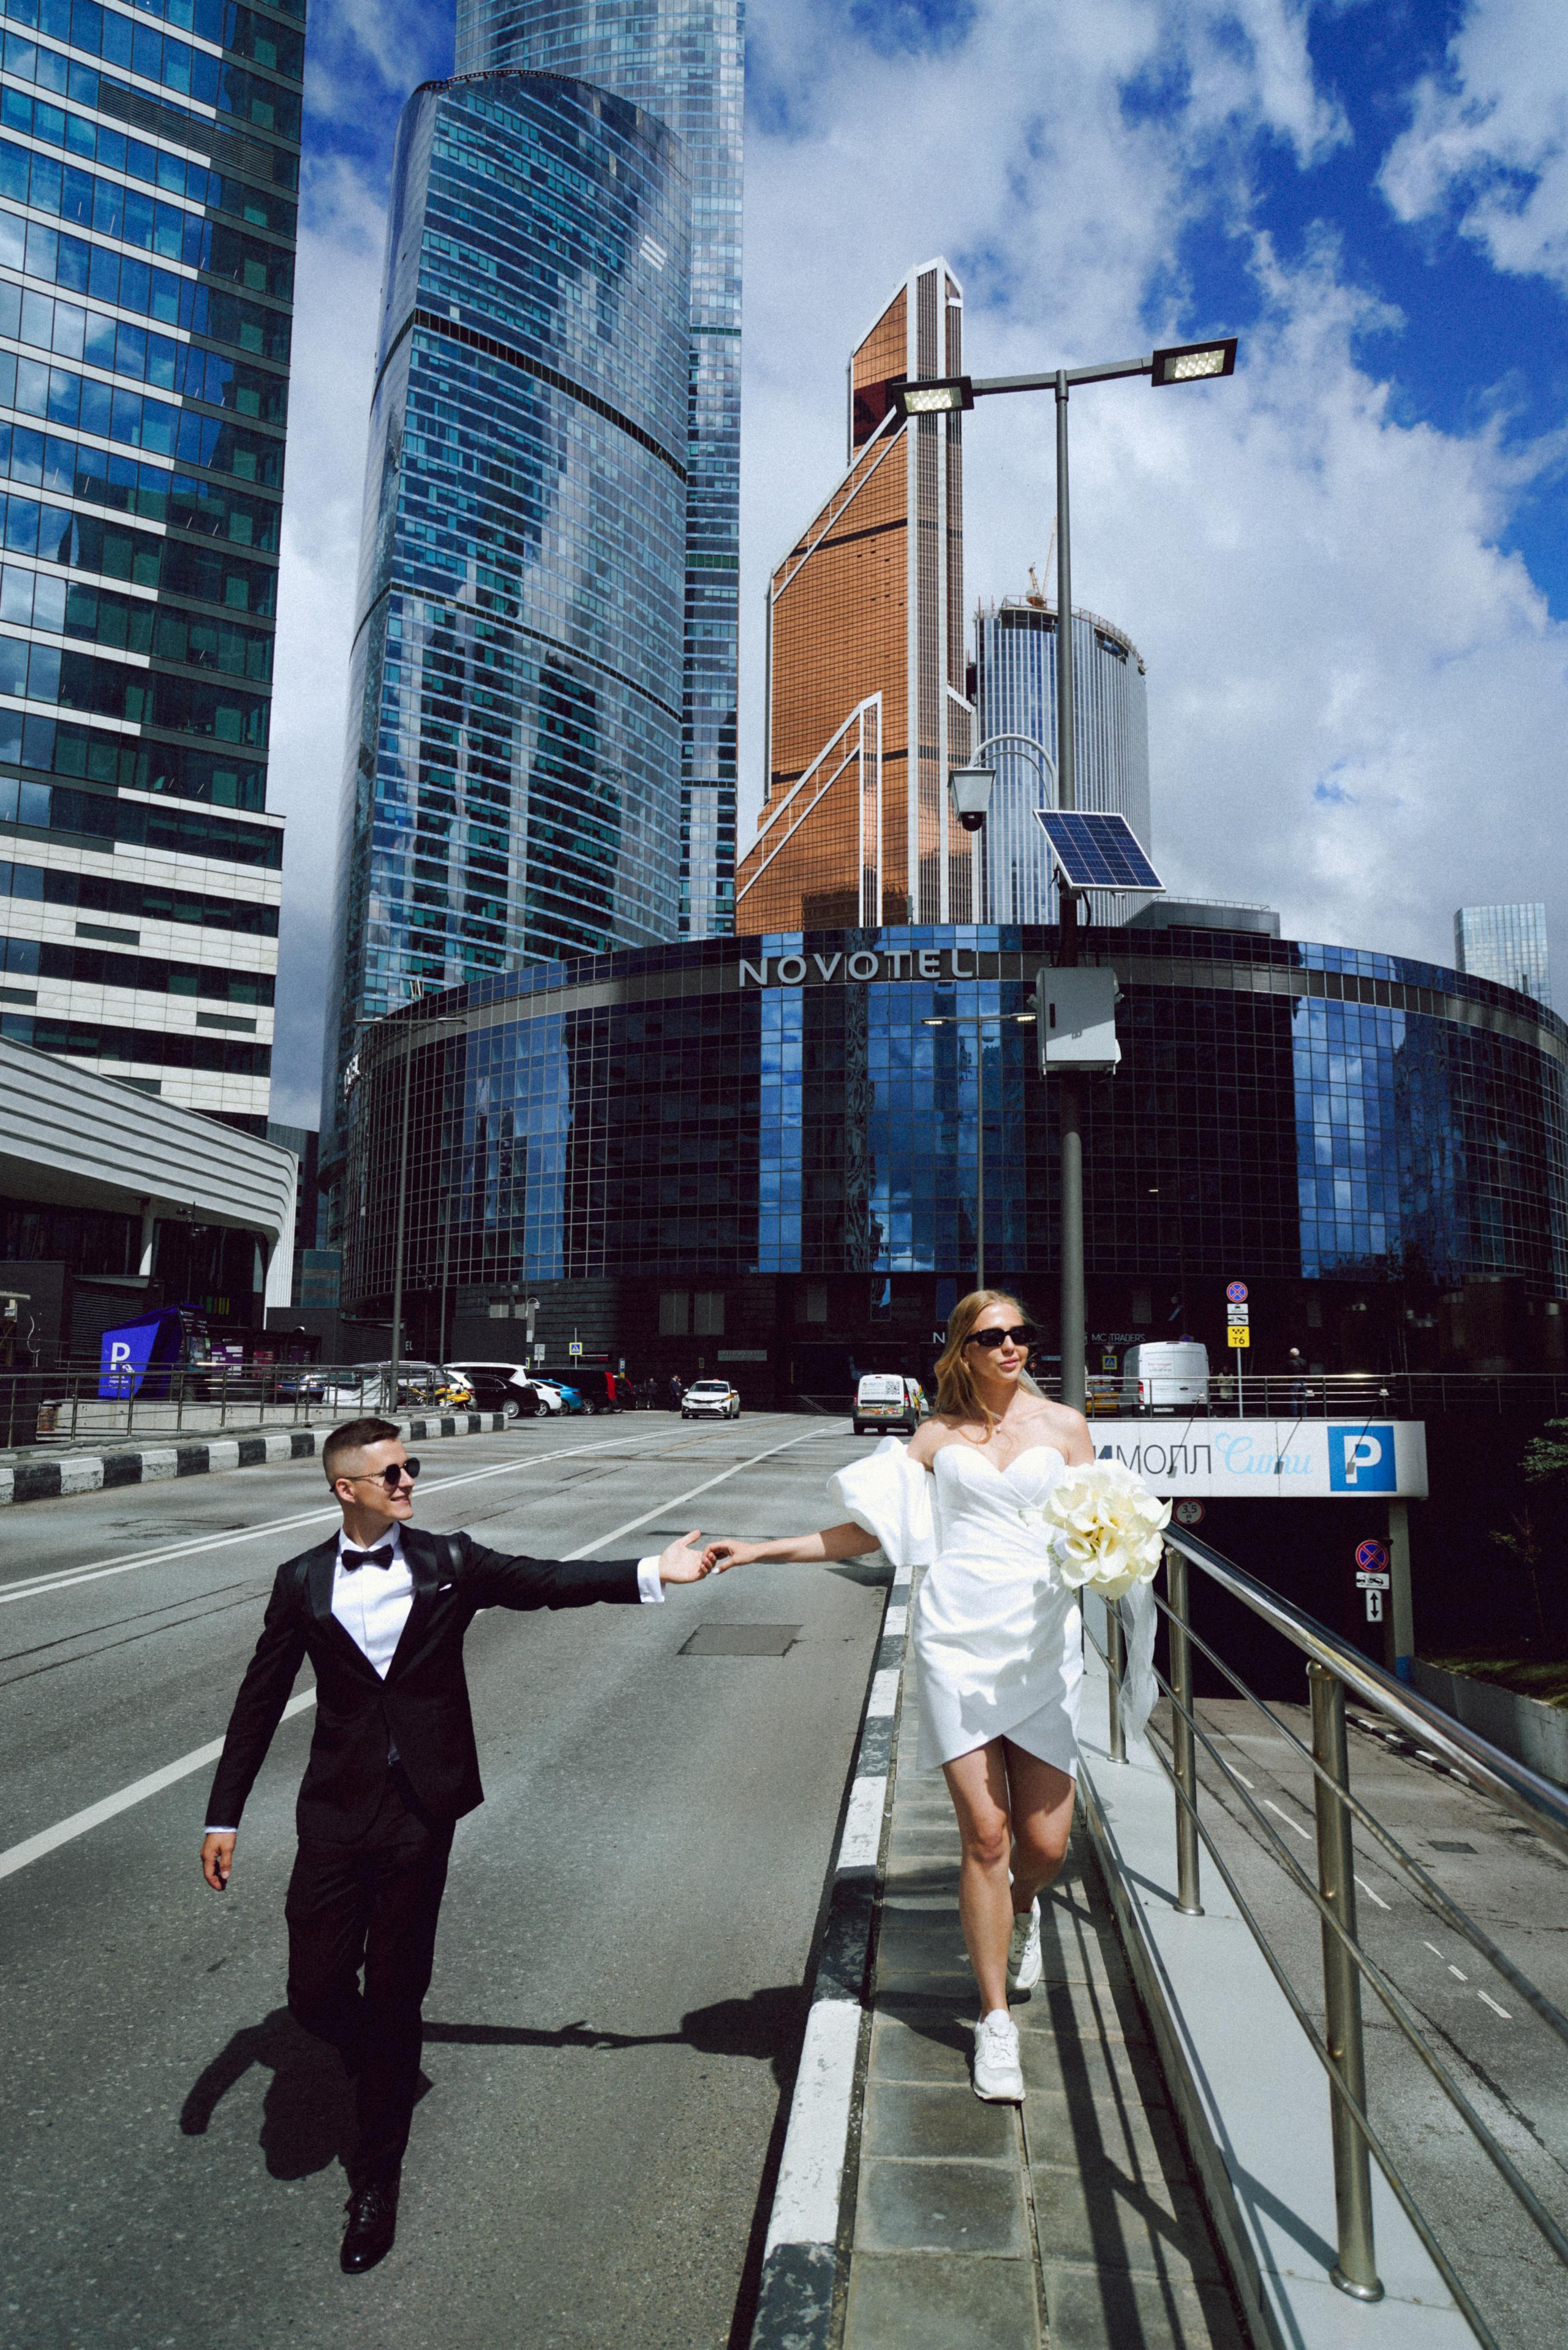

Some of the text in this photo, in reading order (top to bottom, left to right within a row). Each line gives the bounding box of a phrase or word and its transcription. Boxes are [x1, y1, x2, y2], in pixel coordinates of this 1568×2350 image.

[739, 948, 973, 987] NOVOTEL
[110, 1342, 130, 1371] P
[1092, 1333, 1145, 1343] MC TRADERS
[1215, 1432, 1313, 1475] Сити
[1343, 1435, 1382, 1484] P
